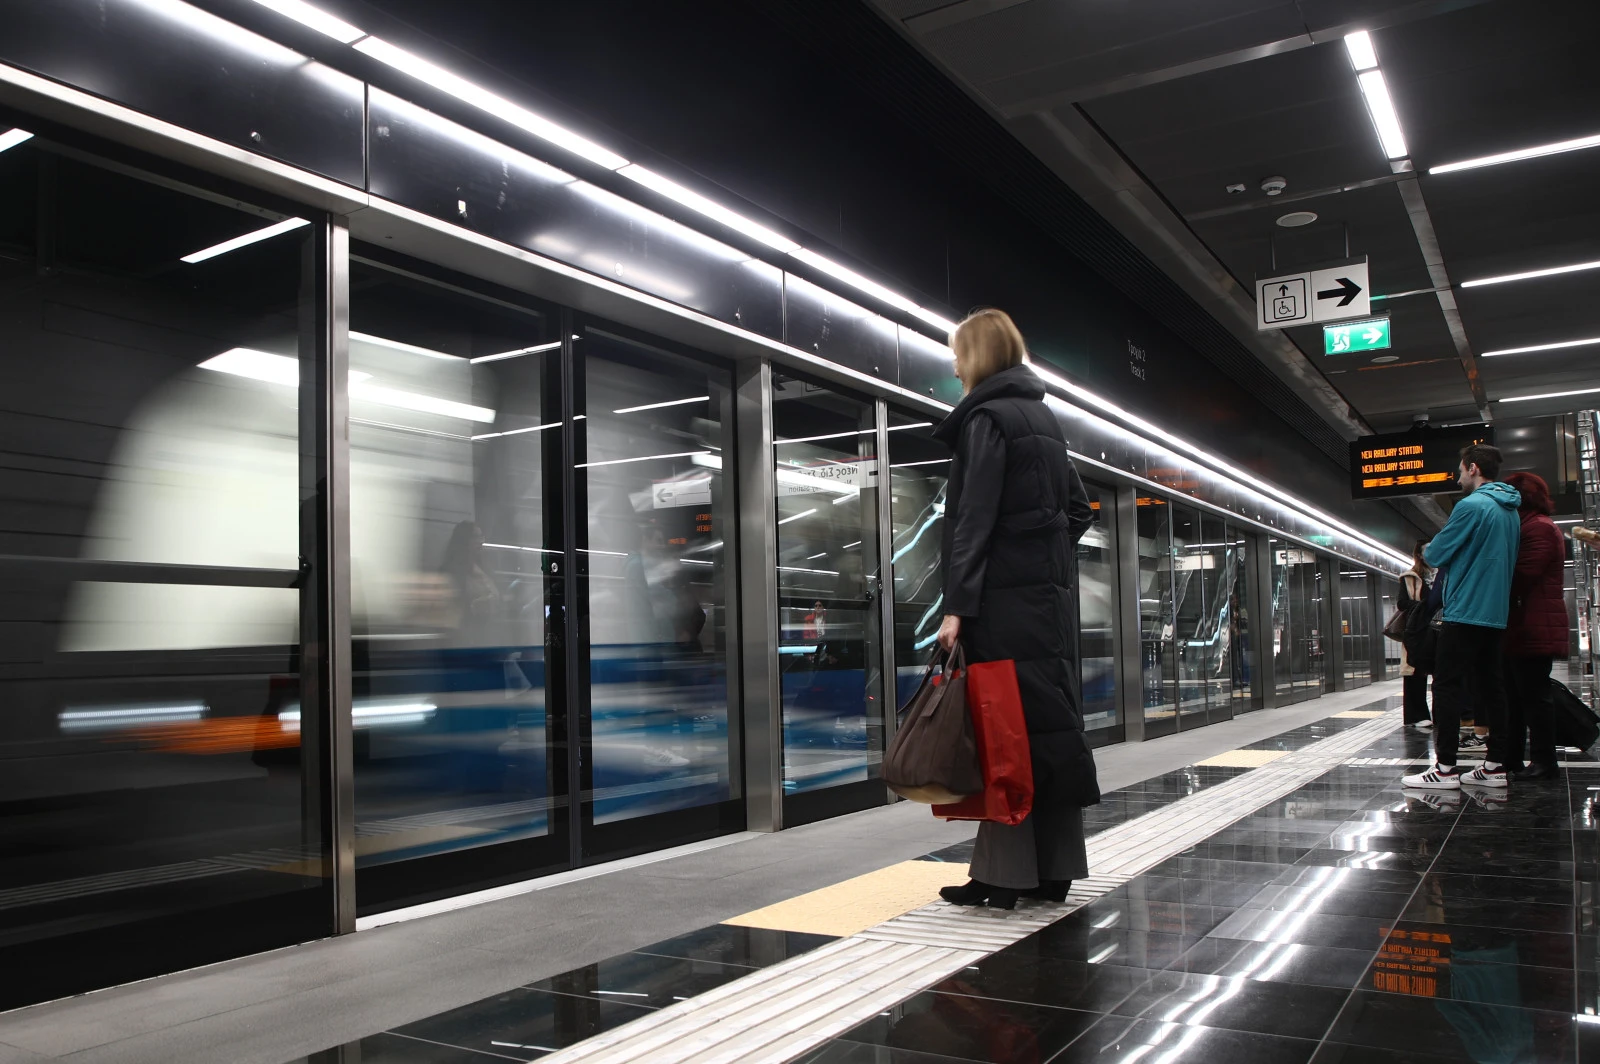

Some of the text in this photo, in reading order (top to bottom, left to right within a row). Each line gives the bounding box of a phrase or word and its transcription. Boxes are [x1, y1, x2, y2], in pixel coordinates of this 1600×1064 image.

[1361, 445, 1423, 459] NEW RAILWAY STATION
[1362, 459, 1424, 474] NEW RAILWAY STATION
